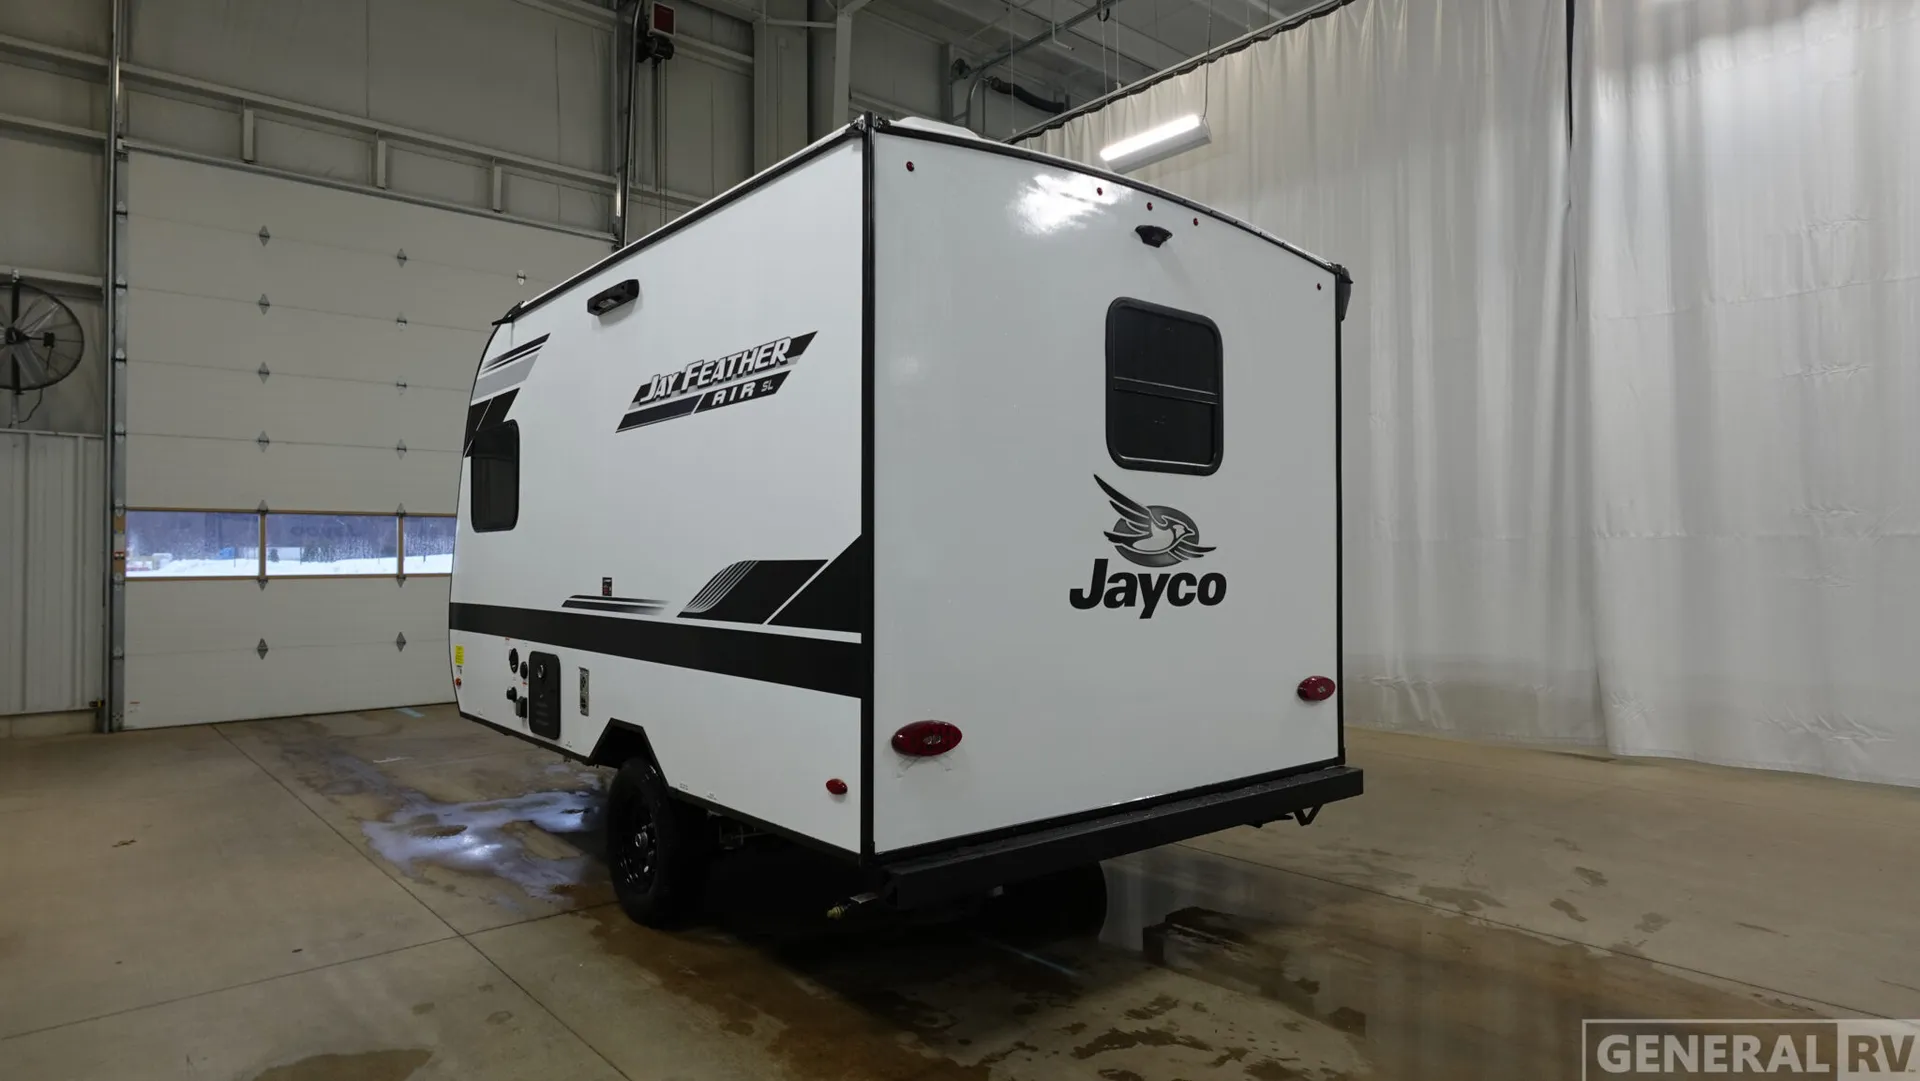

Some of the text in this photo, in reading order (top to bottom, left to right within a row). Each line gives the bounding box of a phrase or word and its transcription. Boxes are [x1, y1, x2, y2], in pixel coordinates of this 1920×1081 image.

[639, 336, 792, 405] JAY FEATHER
[711, 379, 774, 406] AIR SL
[1069, 558, 1227, 619] Jayco
